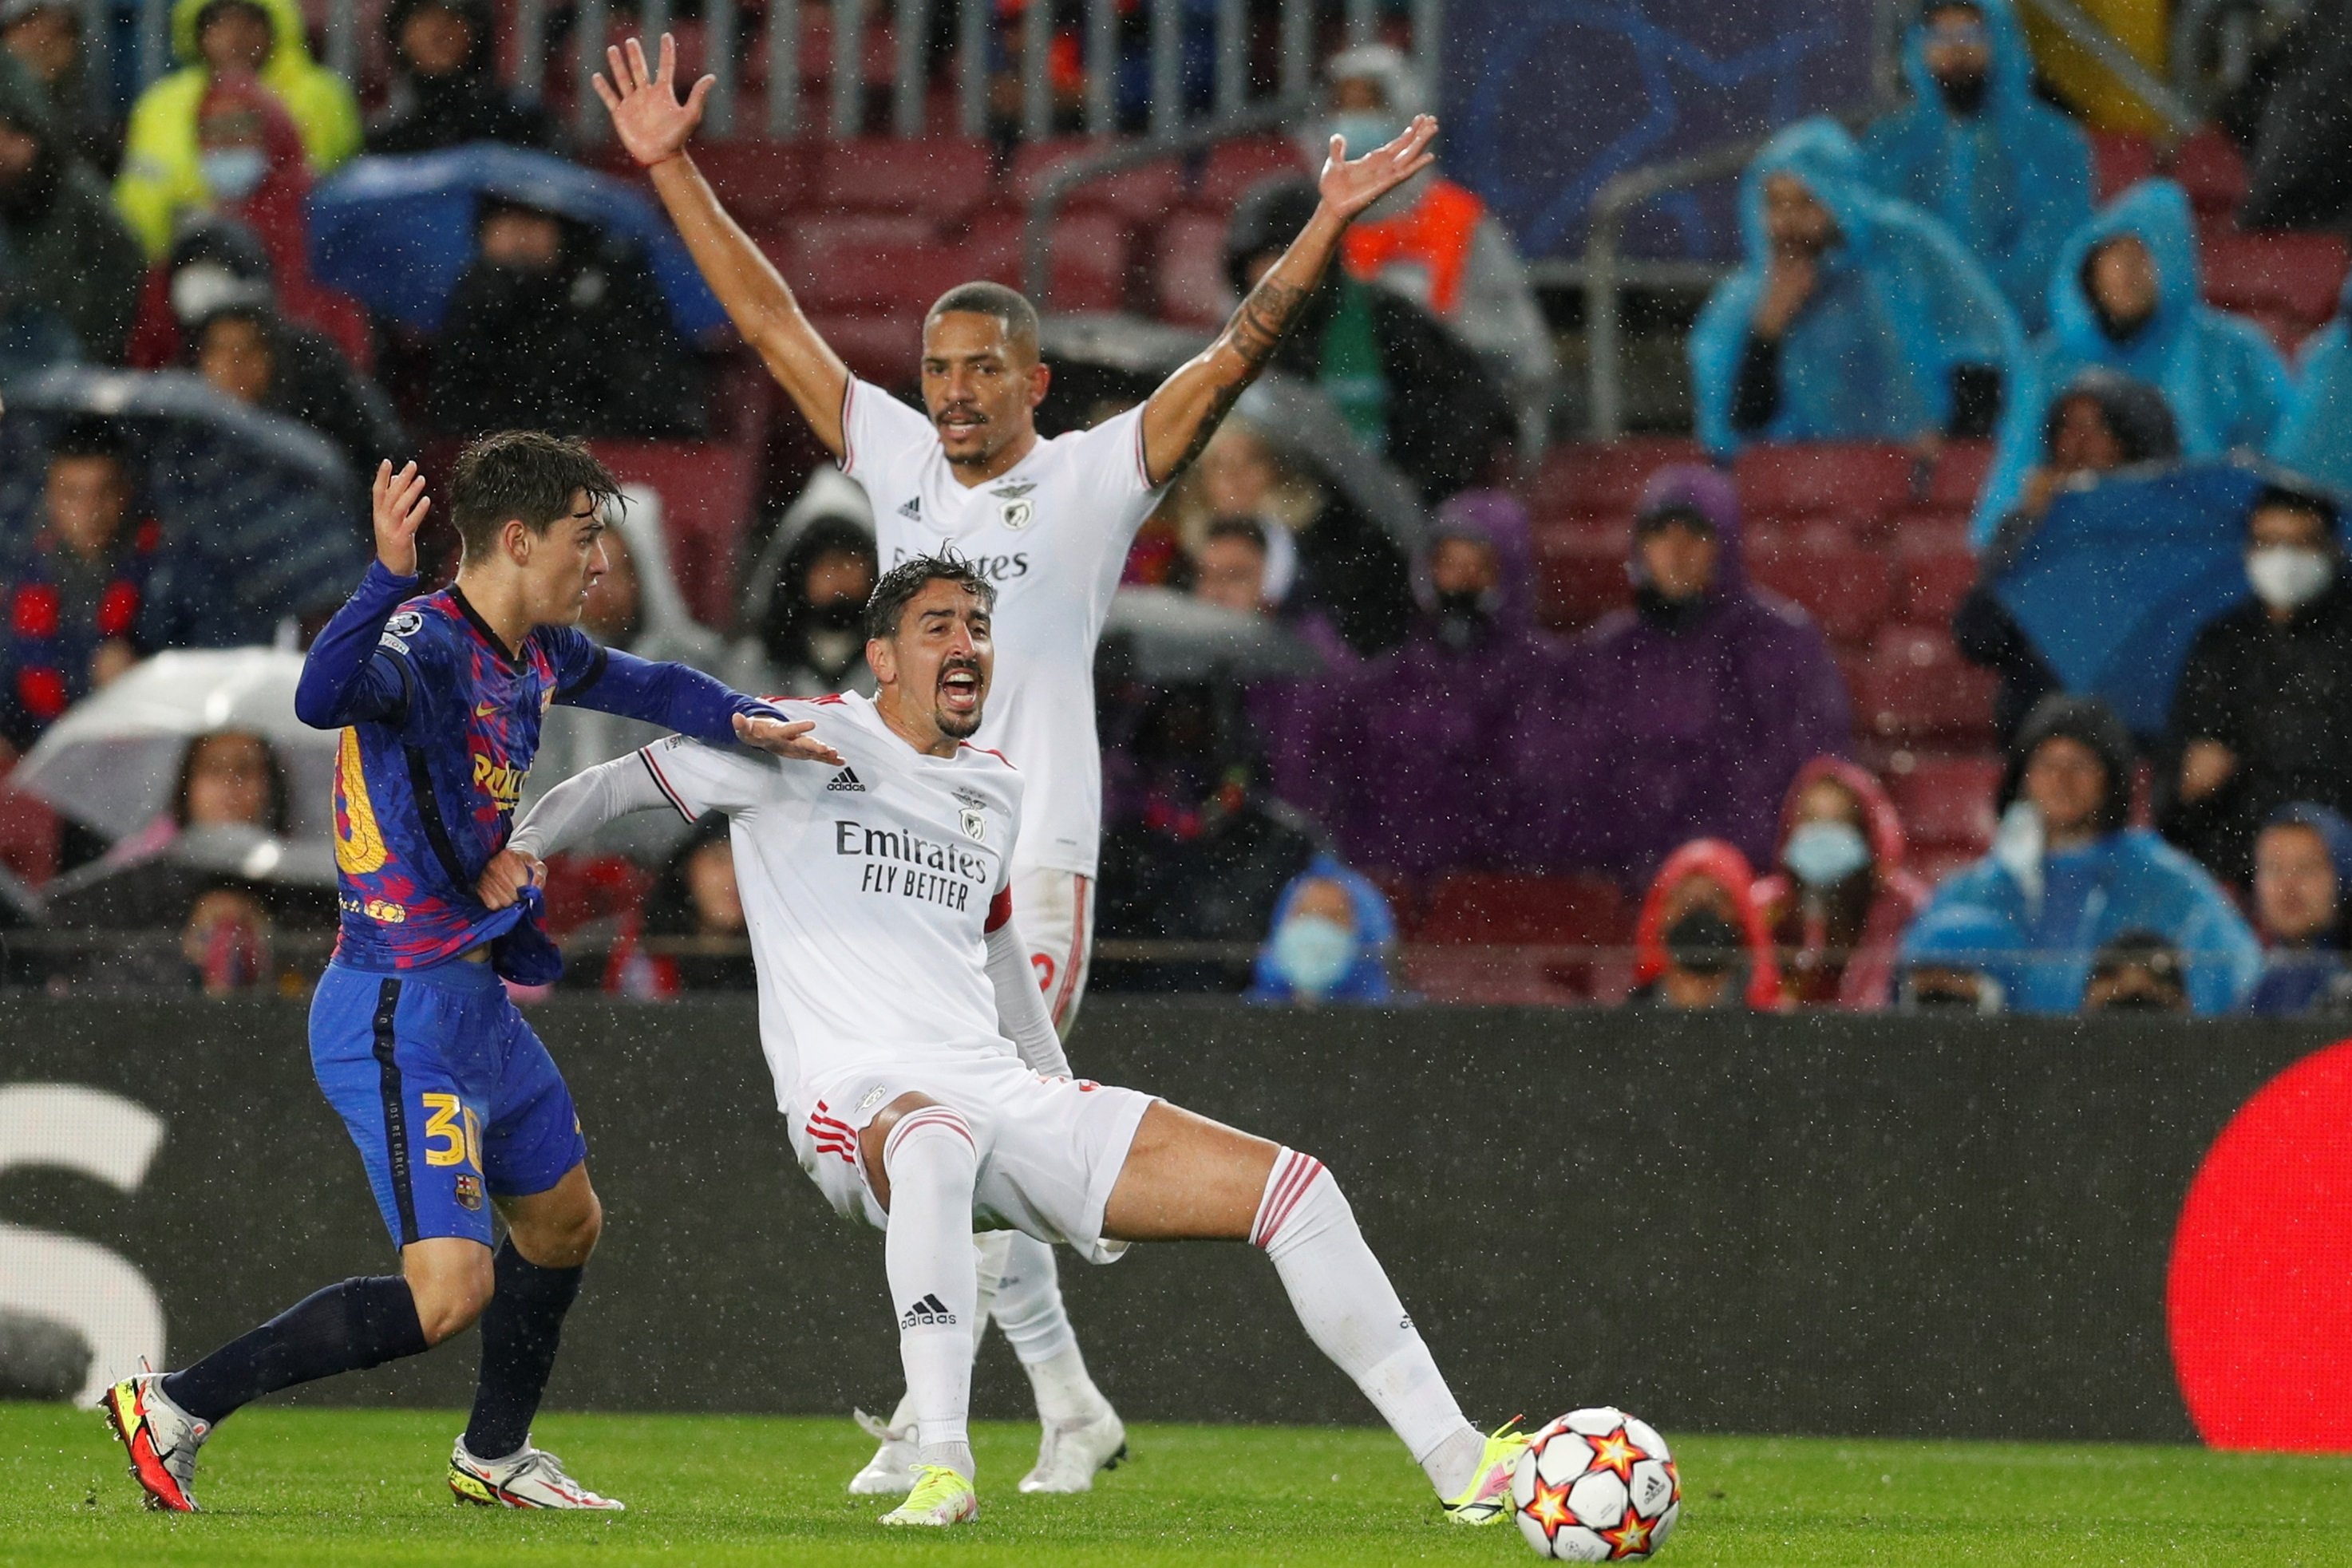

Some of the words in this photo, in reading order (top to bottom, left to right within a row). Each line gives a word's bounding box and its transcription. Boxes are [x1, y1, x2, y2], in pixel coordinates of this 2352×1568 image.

[826, 782, 866, 792] adidas
[835, 820, 986, 884] Emirates
[861, 863, 899, 893] FLY
[903, 869, 969, 912] BETTER
[901, 1312, 957, 1330] adidas
